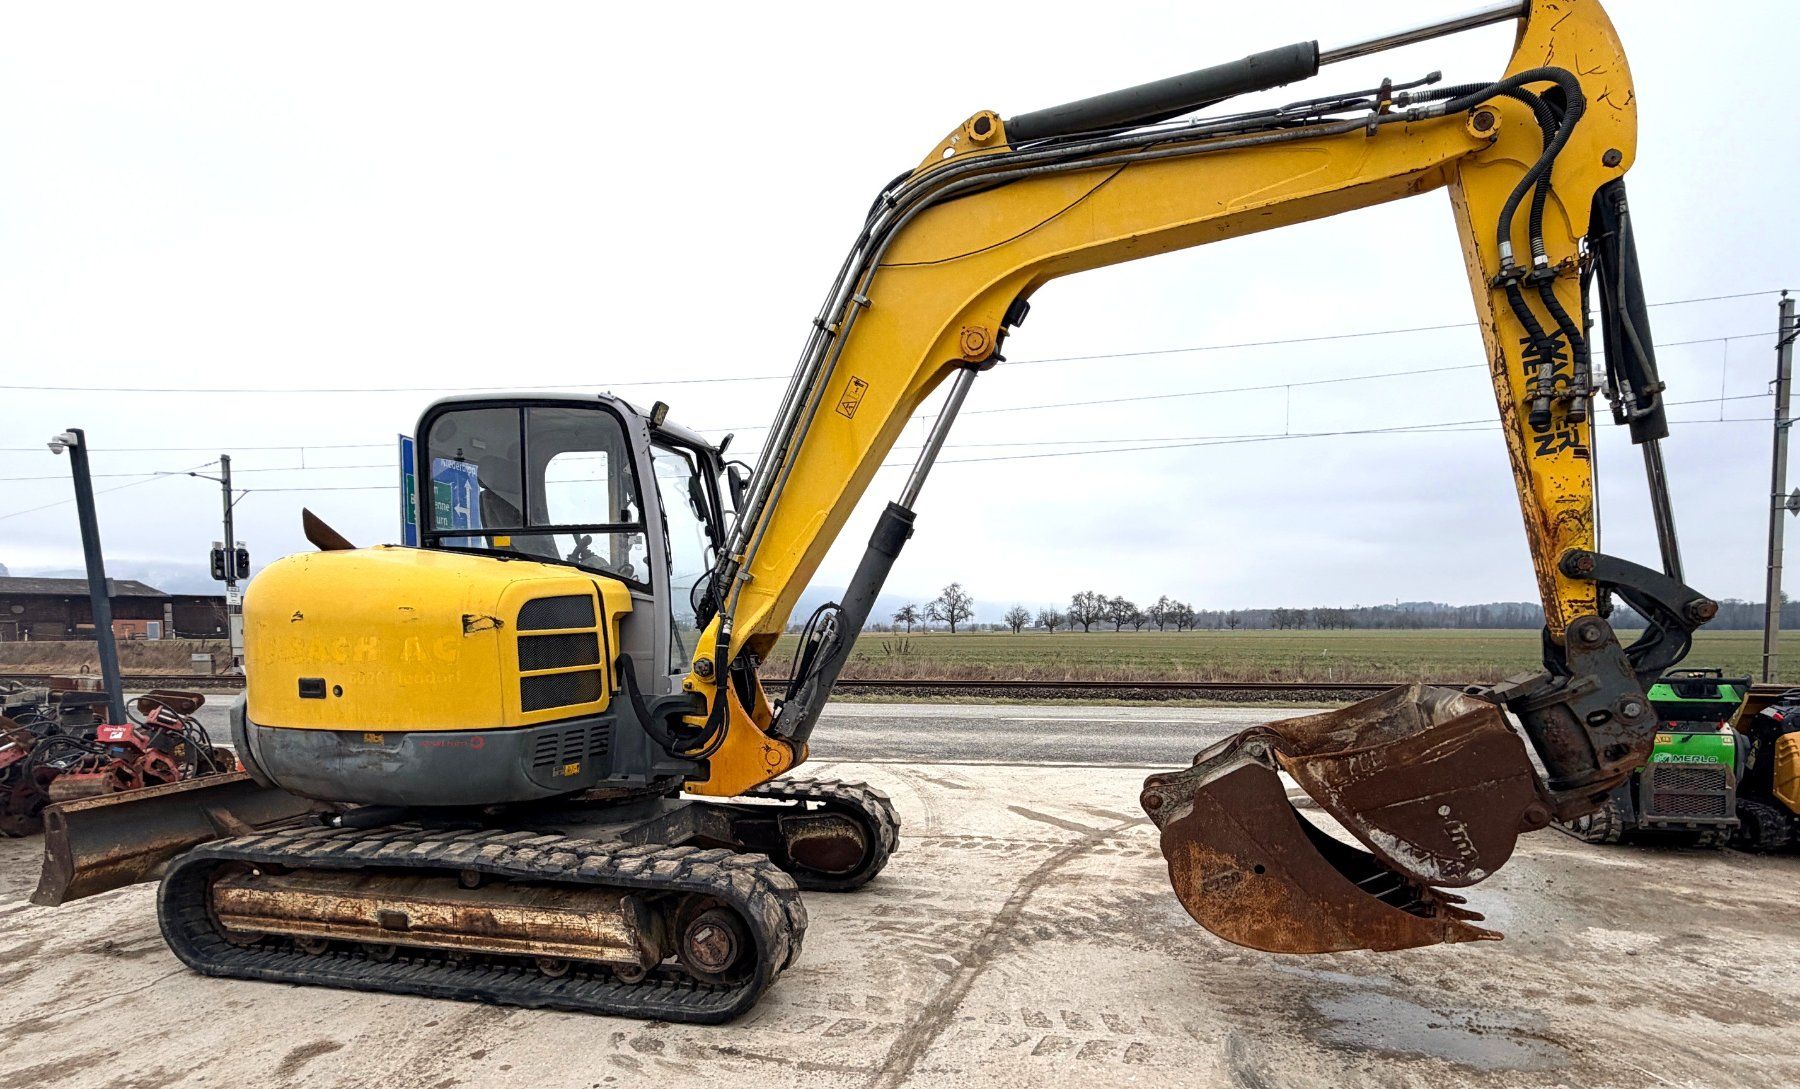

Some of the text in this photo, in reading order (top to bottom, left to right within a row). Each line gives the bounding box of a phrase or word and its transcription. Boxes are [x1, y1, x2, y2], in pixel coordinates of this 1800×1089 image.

[1519, 337, 1558, 456] NEUON
[1547, 328, 1581, 454] WACER
[1672, 754, 1719, 764] MERLO
